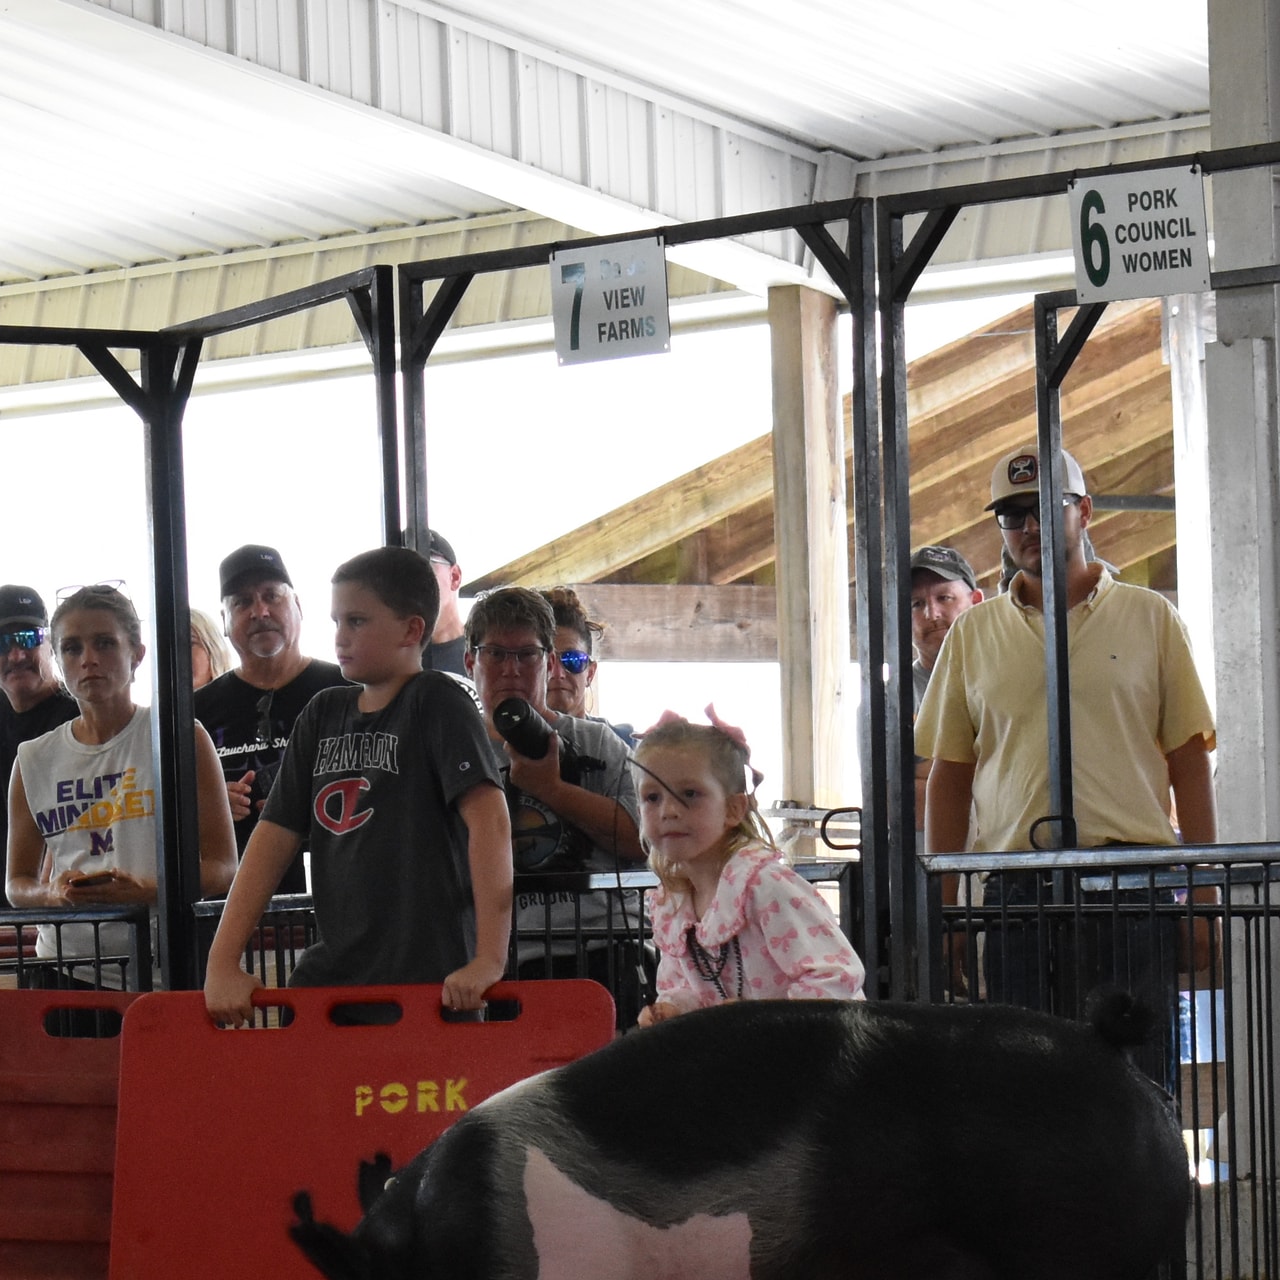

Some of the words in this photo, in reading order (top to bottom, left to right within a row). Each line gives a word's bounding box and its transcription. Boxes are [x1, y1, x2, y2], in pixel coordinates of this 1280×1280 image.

[1128, 187, 1178, 213] PORK
[1080, 189, 1110, 288] 6
[1115, 217, 1196, 244] COUNCIL
[1122, 247, 1192, 273] WOMEN
[561, 262, 586, 351] 7
[603, 286, 645, 311] VIEW
[597, 315, 656, 343] FARMS
[57, 767, 137, 804] ELITE
[90, 828, 114, 856] M
[356, 1077, 468, 1116] PORK
